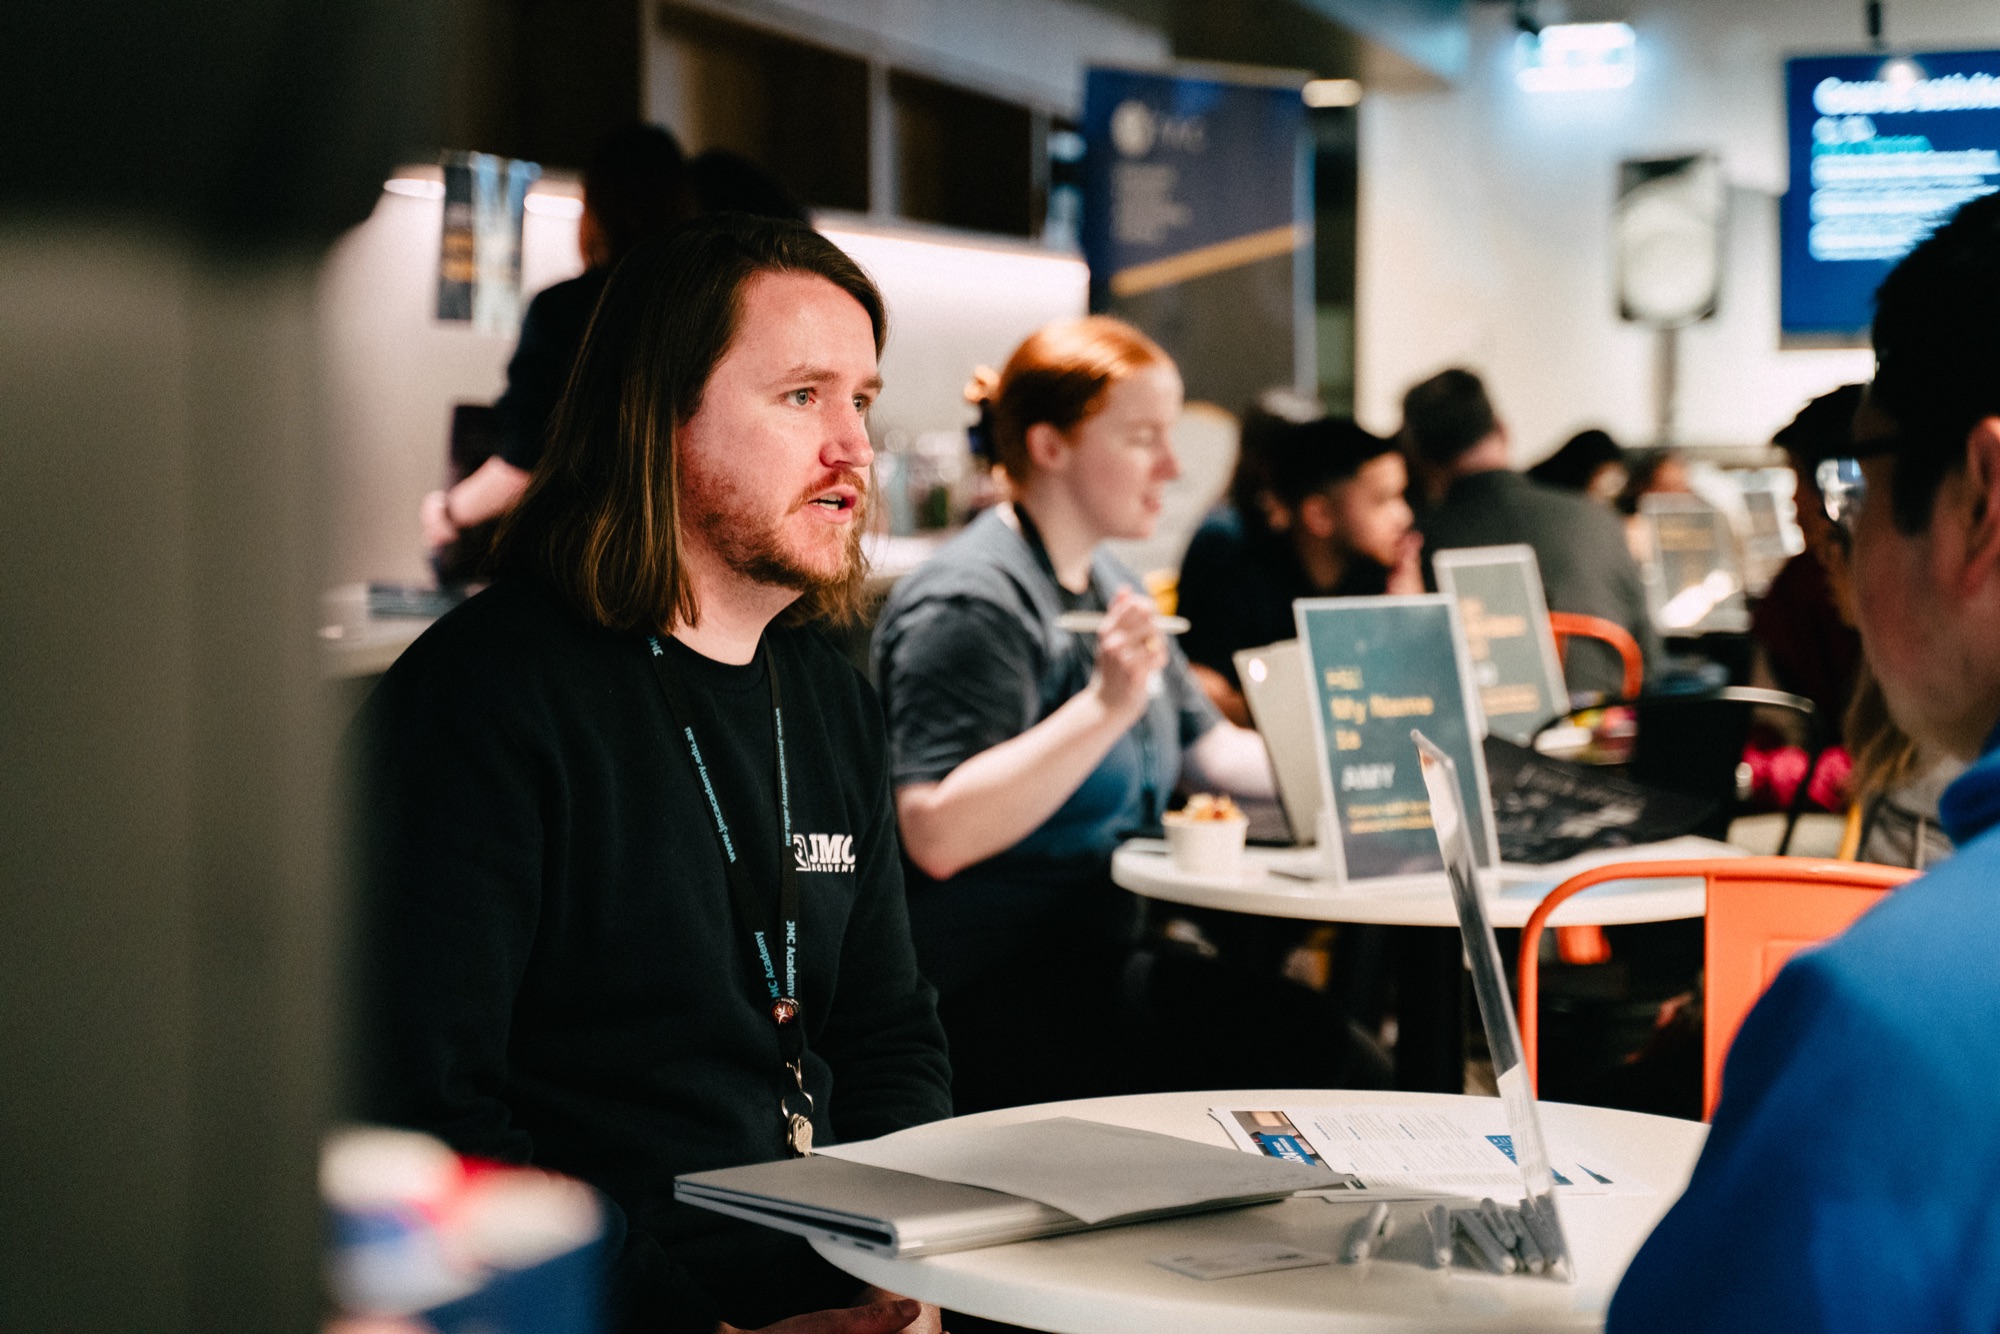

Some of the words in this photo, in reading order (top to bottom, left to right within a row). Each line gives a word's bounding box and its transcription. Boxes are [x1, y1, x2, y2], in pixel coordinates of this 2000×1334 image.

[775, 707, 791, 846] www.jmcacademy.edu.au
[685, 726, 736, 863] www.jmcacademy.edu.au
[809, 834, 856, 865] JMC
[811, 863, 856, 873] ACADEMY
[786, 920, 796, 945] JMC
[754, 931, 775, 979] Academy
[767, 980, 781, 999] MC
